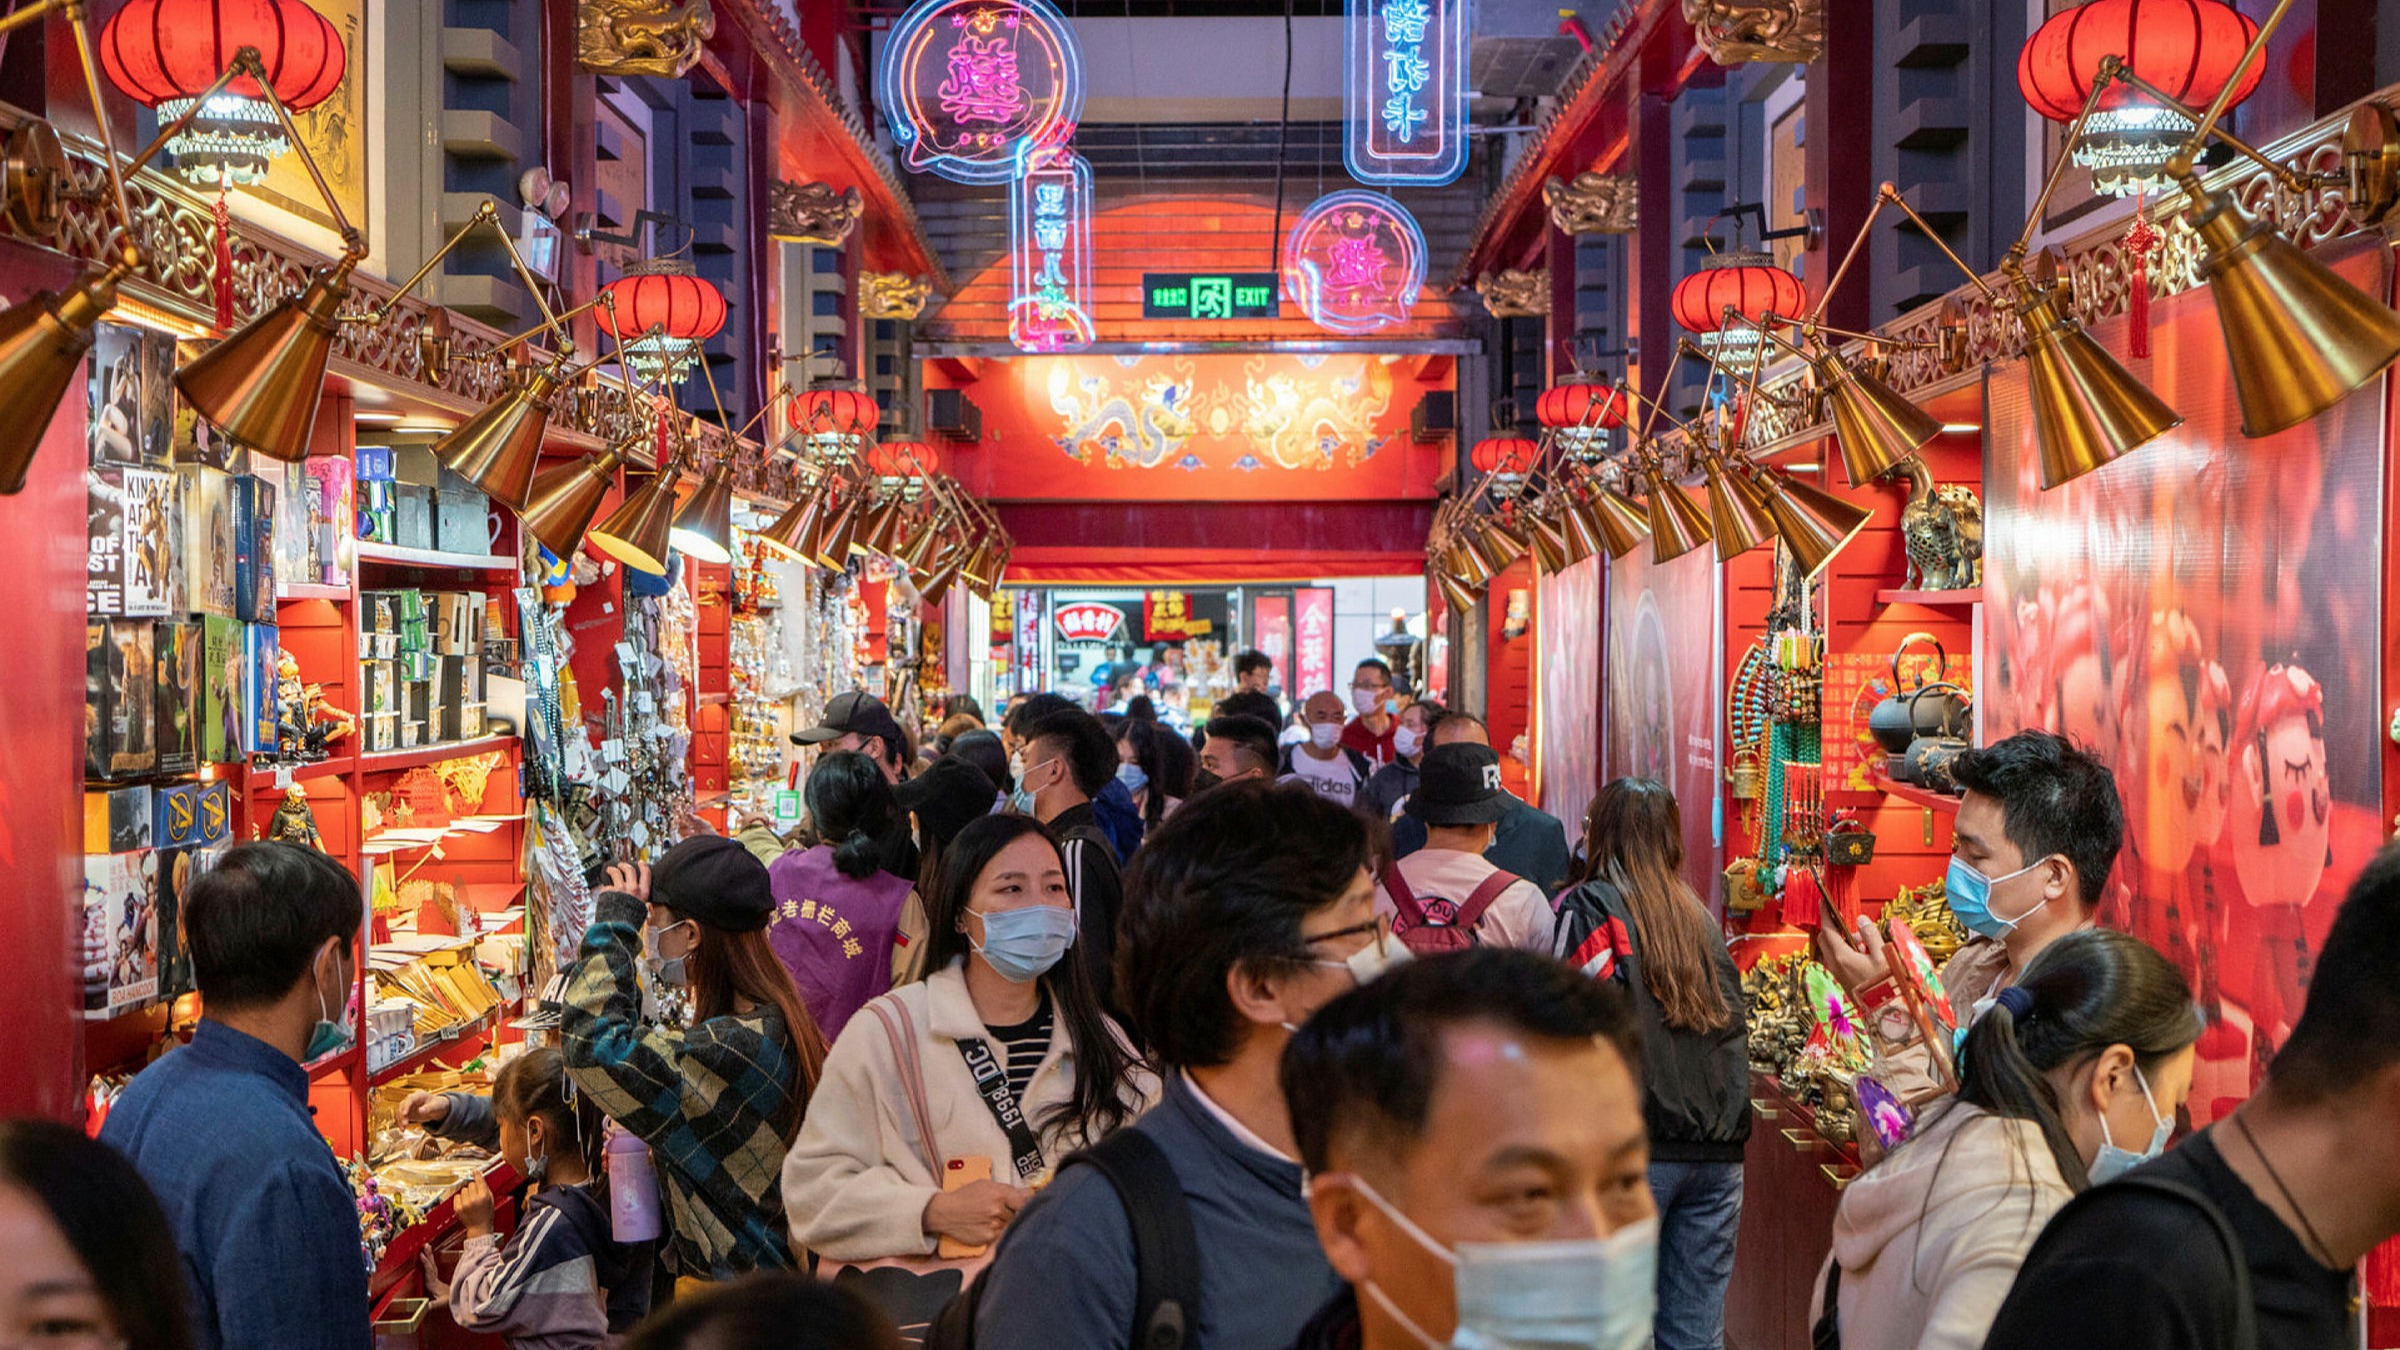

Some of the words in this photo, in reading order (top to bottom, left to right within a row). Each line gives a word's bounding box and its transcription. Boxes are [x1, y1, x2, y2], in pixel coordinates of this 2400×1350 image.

[1236, 287, 1270, 307] EXIT
[91, 536, 120, 554] OF
[1307, 776, 1353, 796] didas
[1481, 763, 1501, 790] R
